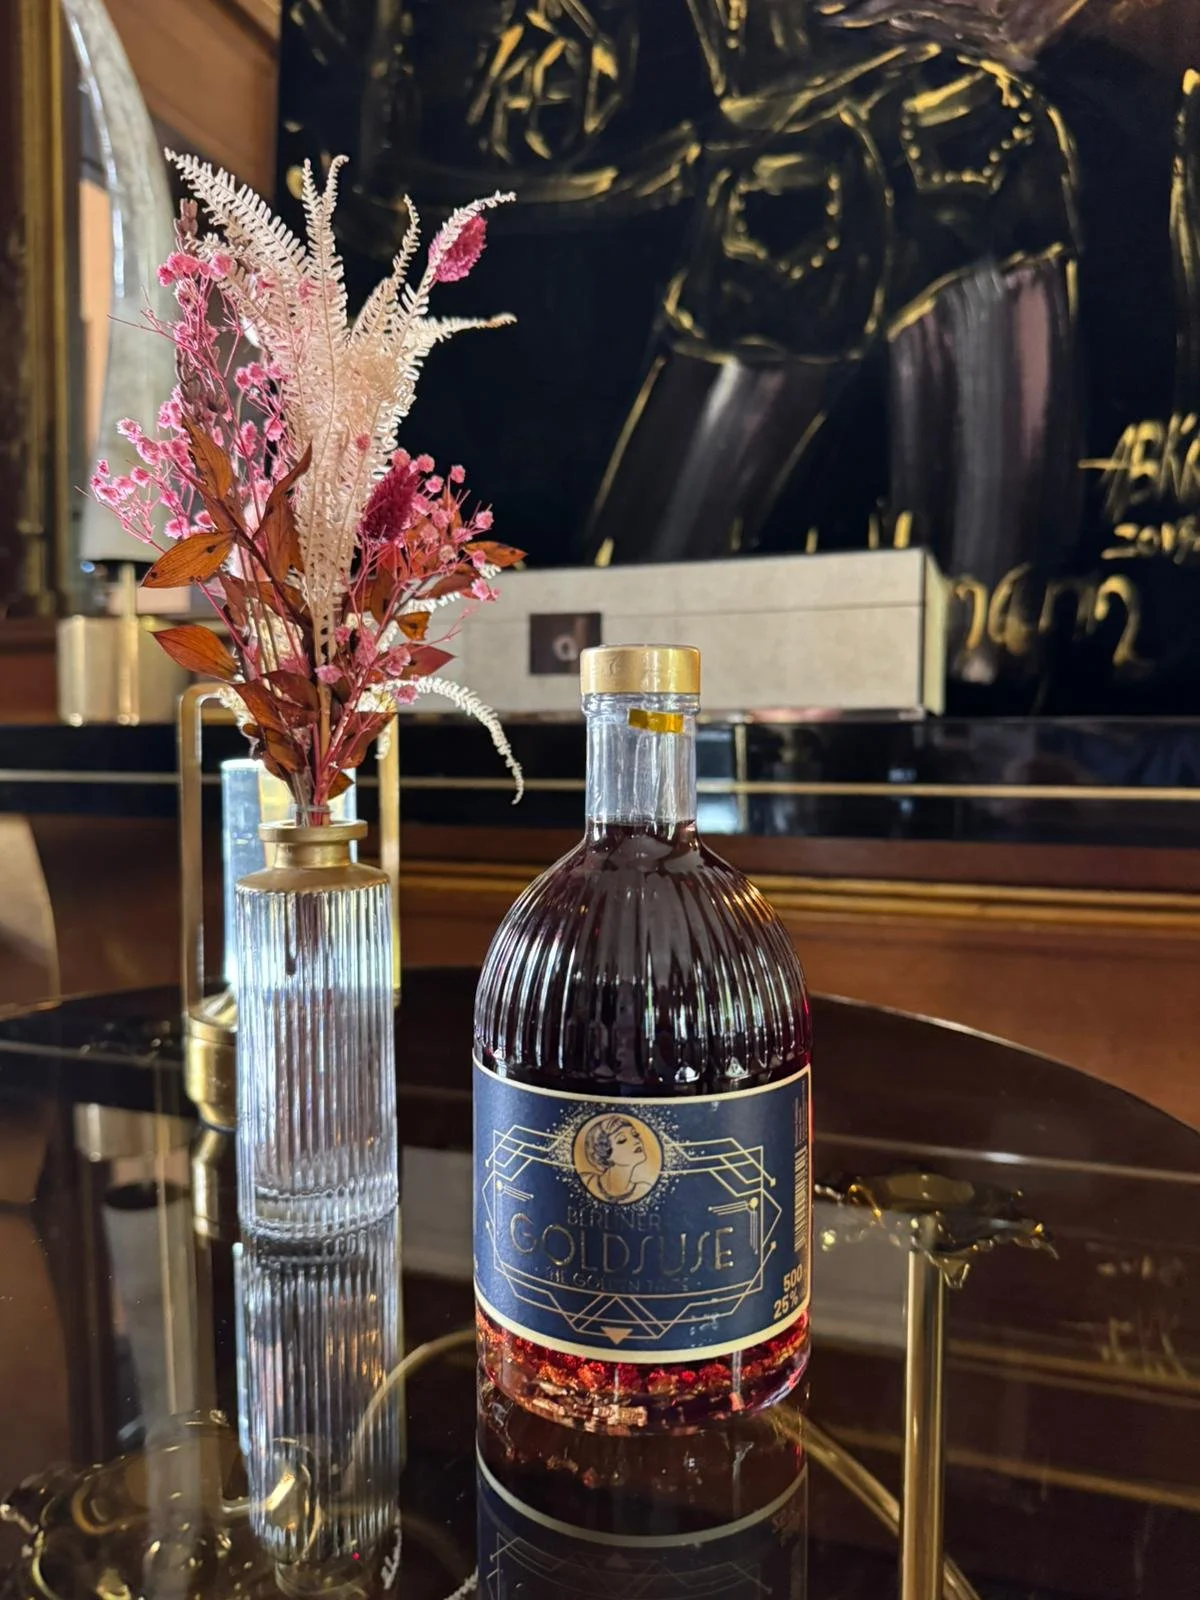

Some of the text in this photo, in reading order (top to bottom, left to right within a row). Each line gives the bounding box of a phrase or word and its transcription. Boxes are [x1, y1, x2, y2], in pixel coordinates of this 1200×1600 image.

[567, 1206, 662, 1232] BERLINER
[509, 1212, 734, 1277] GOLDSUSE
[783, 1263, 803, 1292] 500
